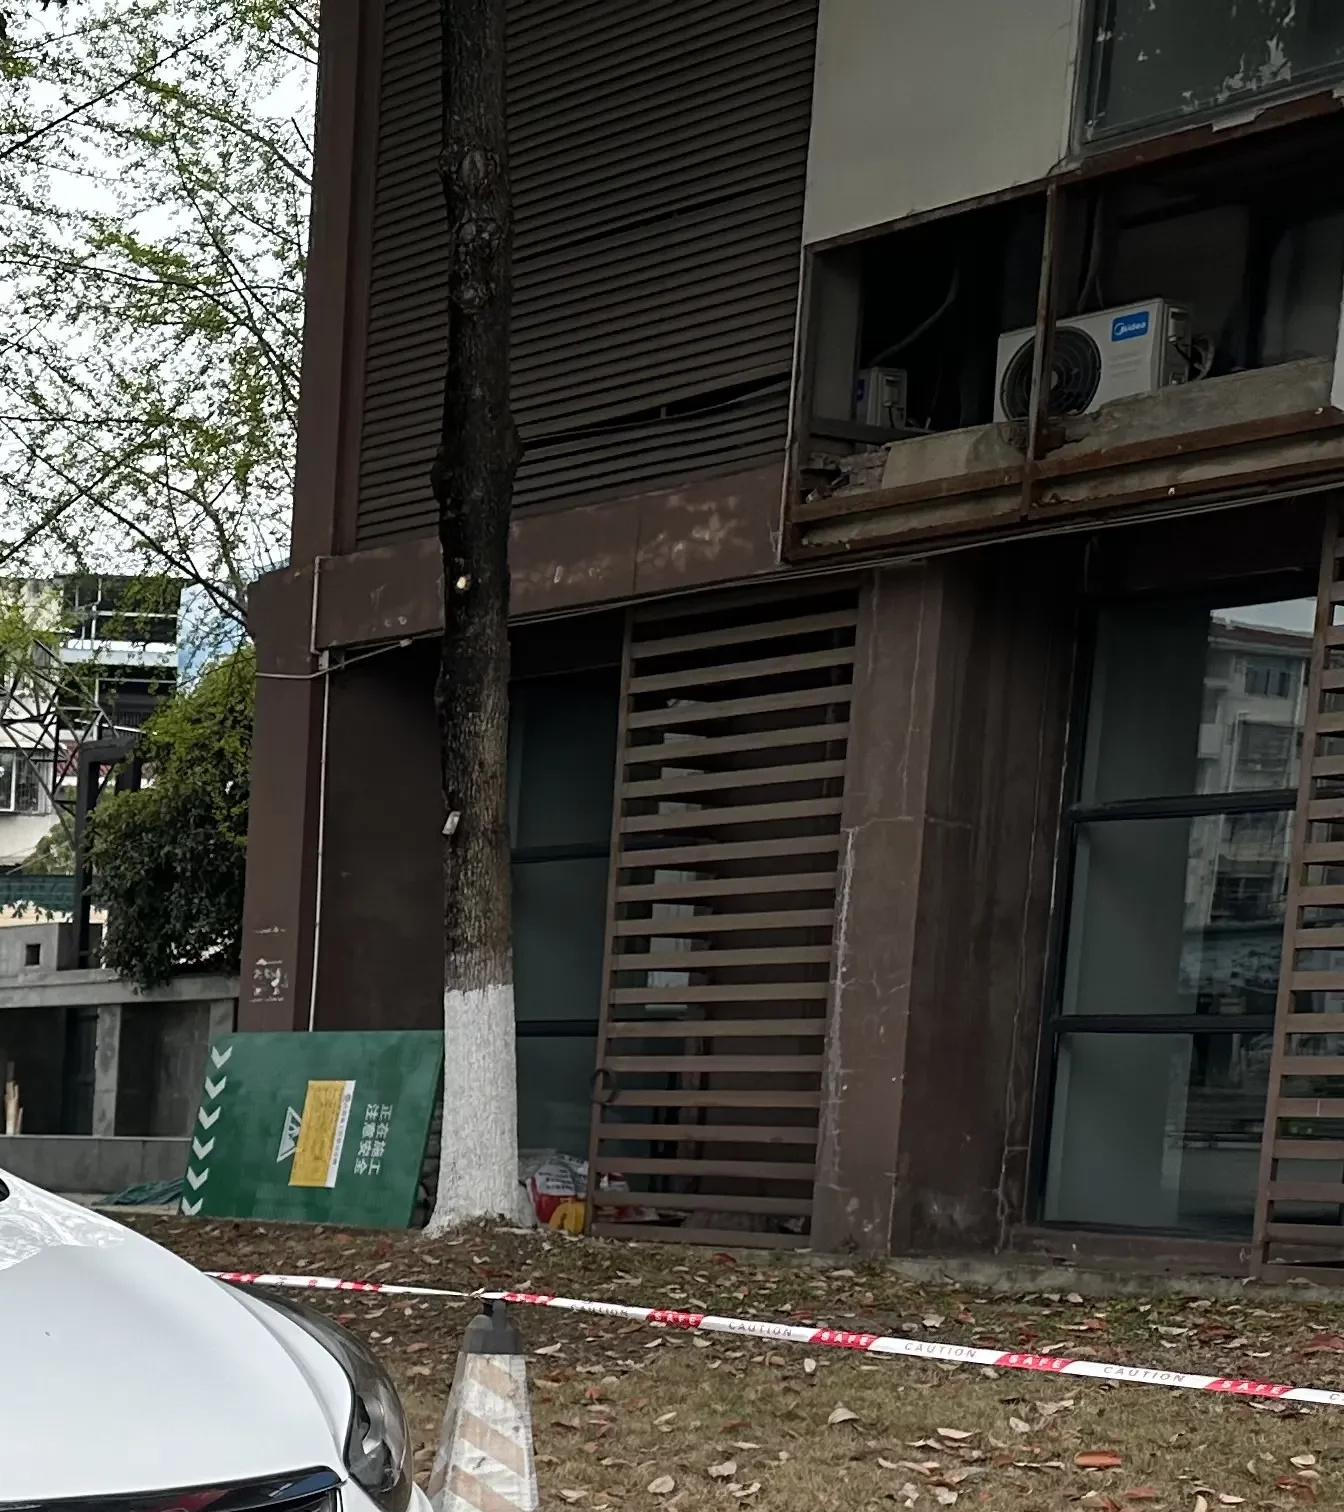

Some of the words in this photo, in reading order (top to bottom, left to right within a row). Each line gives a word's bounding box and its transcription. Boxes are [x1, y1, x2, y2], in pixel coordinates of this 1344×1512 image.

[353, 1104, 379, 1175] 注意安全
[368, 1104, 393, 1175] 正在施工
[654, 1311, 698, 1326] SAFE
[728, 1321, 793, 1337] CAUTION
[820, 1330, 870, 1346] SAFE
[904, 1341, 977, 1359] CAUTION
[1008, 1353, 1062, 1370] SAFE
[1103, 1366, 1186, 1383] CAUTION
[1221, 1380, 1282, 1396] SAFE
